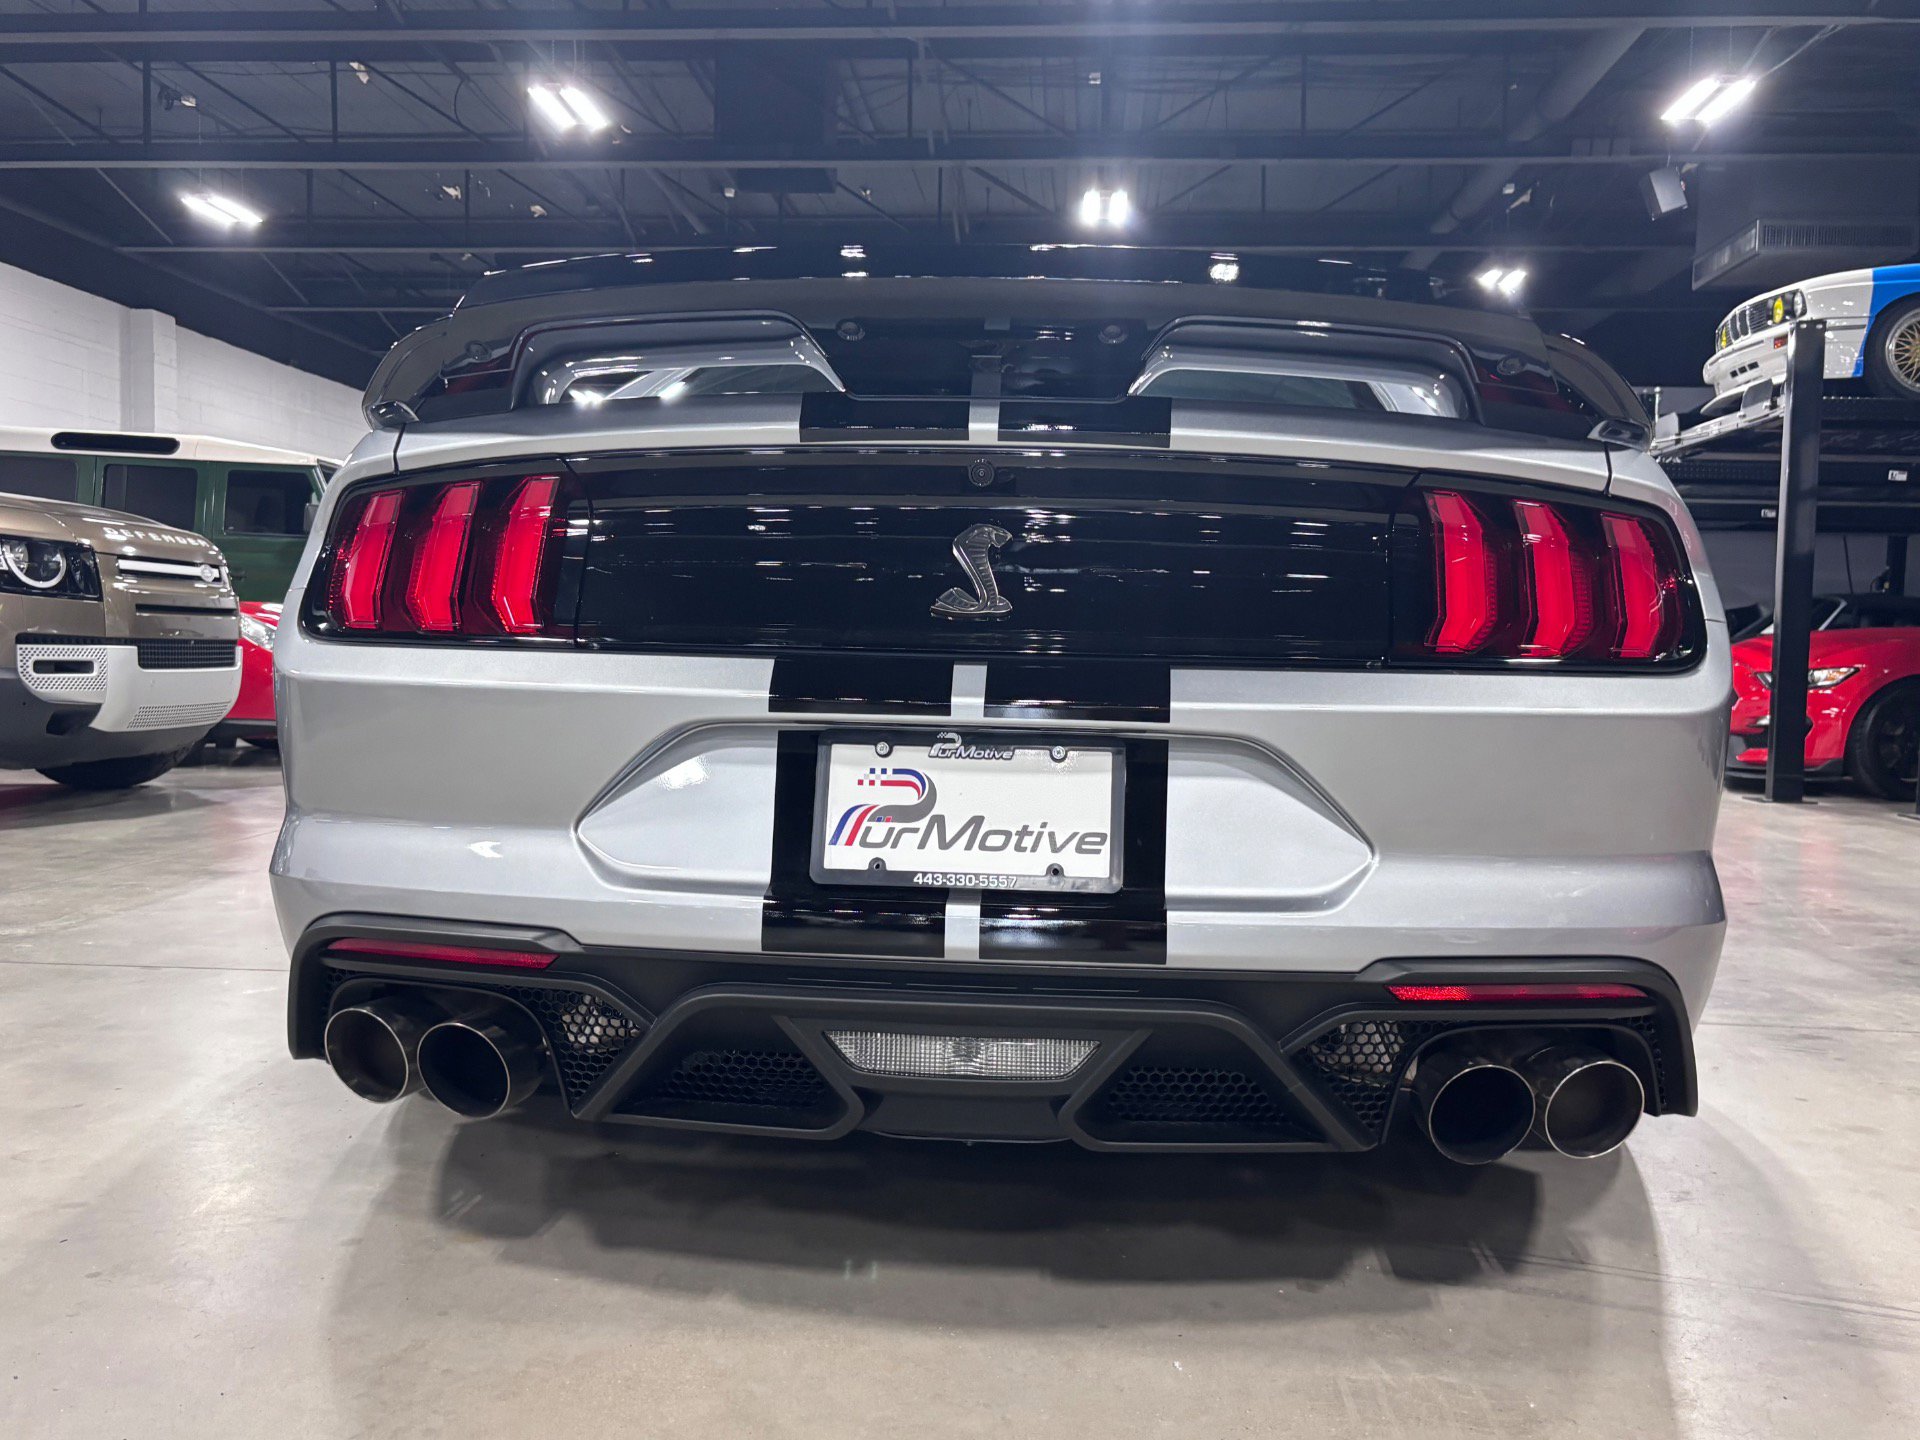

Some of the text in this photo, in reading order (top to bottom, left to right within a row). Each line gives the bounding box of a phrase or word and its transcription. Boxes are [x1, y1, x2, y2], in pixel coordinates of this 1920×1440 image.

[929, 732, 1013, 759] PurMotive
[828, 768, 1108, 855] PurMotive
[913, 873, 1017, 888] 443-330-5557
